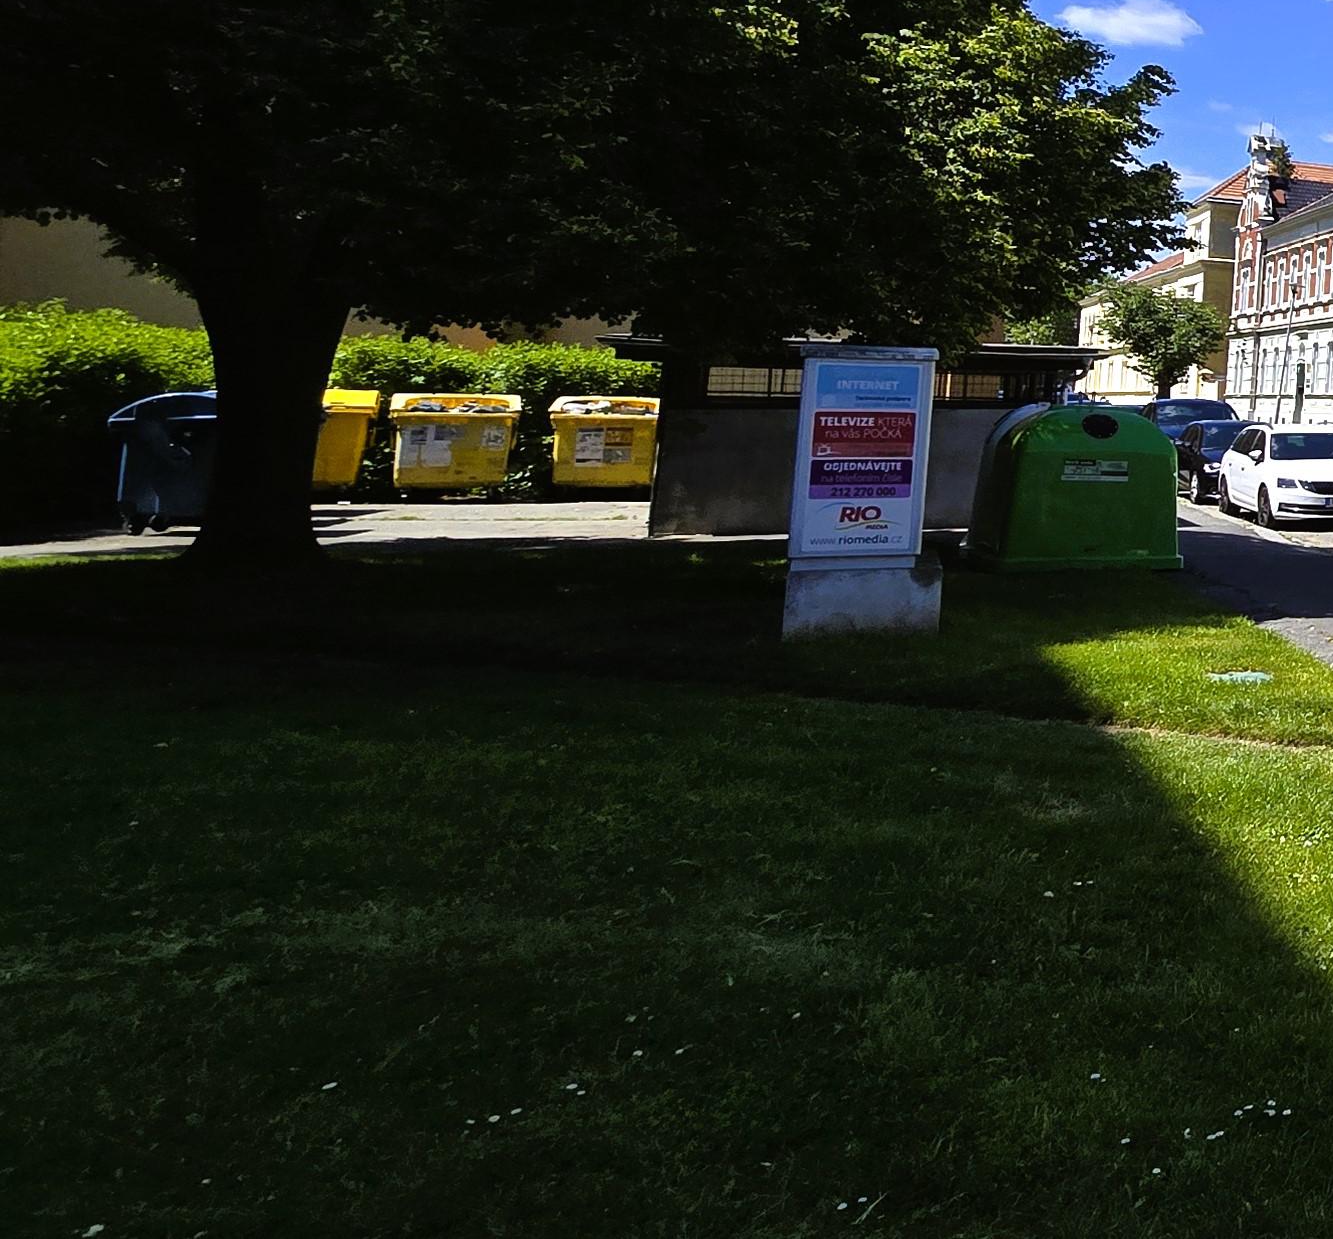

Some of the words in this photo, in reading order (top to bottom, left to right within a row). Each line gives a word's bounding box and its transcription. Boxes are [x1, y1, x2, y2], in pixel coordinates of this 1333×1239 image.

[836, 379, 899, 391] INTERNET
[820, 416, 875, 427] TELEVIZE
[877, 415, 912, 426] KTERÁ
[825, 430, 839, 439] na
[841, 428, 860, 439] vás
[863, 426, 902, 439] POČKÁ
[830, 487, 851, 497] 212
[853, 487, 874, 497] 270
[839, 505, 882, 523] RIO
